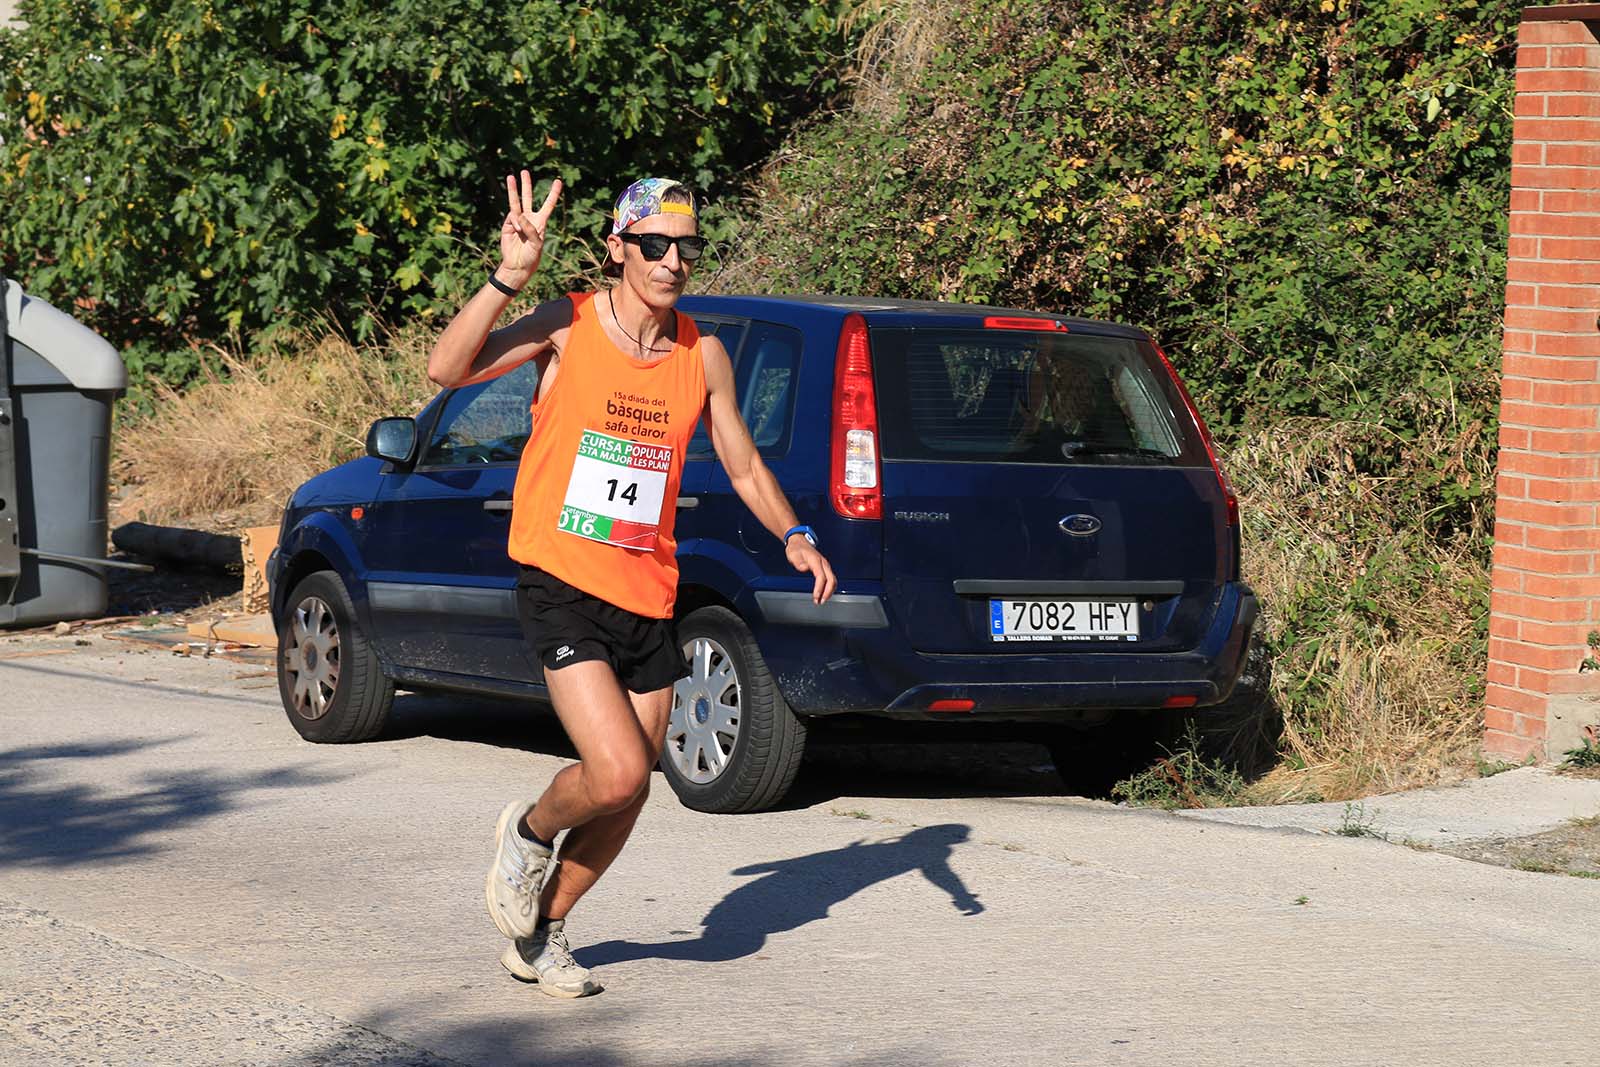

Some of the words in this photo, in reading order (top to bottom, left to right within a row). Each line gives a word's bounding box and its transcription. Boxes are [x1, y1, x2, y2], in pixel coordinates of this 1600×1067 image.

[614, 392, 626, 401] 15a
[627, 394, 649, 405] diada
[652, 399, 665, 407] del
[607, 400, 669, 425] bàsquet
[605, 421, 628, 433] safa
[631, 425, 666, 439] claror
[581, 434, 622, 454] CURSA
[625, 445, 671, 461] POPULAR
[599, 450, 632, 465] MAJOR
[633, 458, 647, 468] LES
[607, 479, 638, 506] 14
[566, 507, 598, 521] setembre
[894, 511, 949, 521] FUSION
[994, 620, 1001, 629] E
[1012, 602, 1076, 631] 7082
[1089, 603, 1131, 631] HFY
